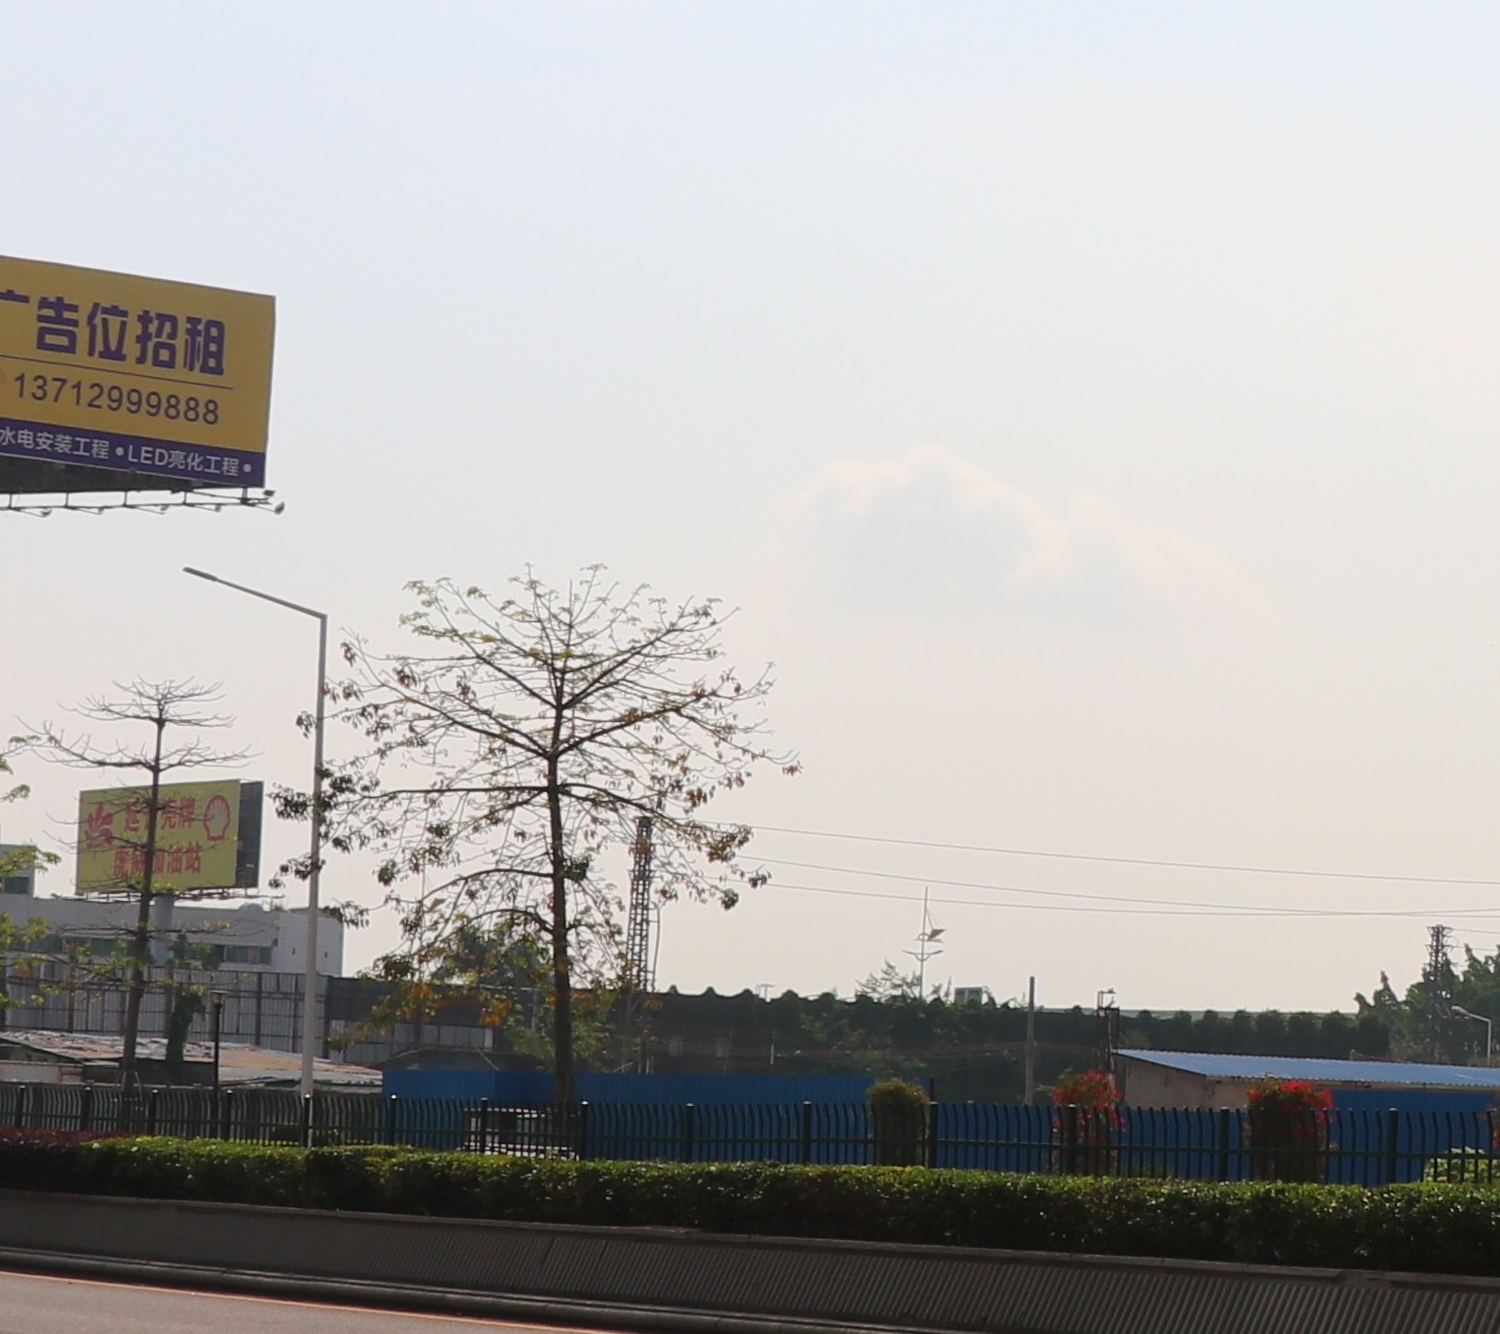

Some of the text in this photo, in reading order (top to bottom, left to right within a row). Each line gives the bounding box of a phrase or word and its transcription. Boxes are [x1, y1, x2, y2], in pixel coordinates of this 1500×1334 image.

[13, 372, 220, 425] 13712999888
[128, 448, 239, 477] LED亮化工程
